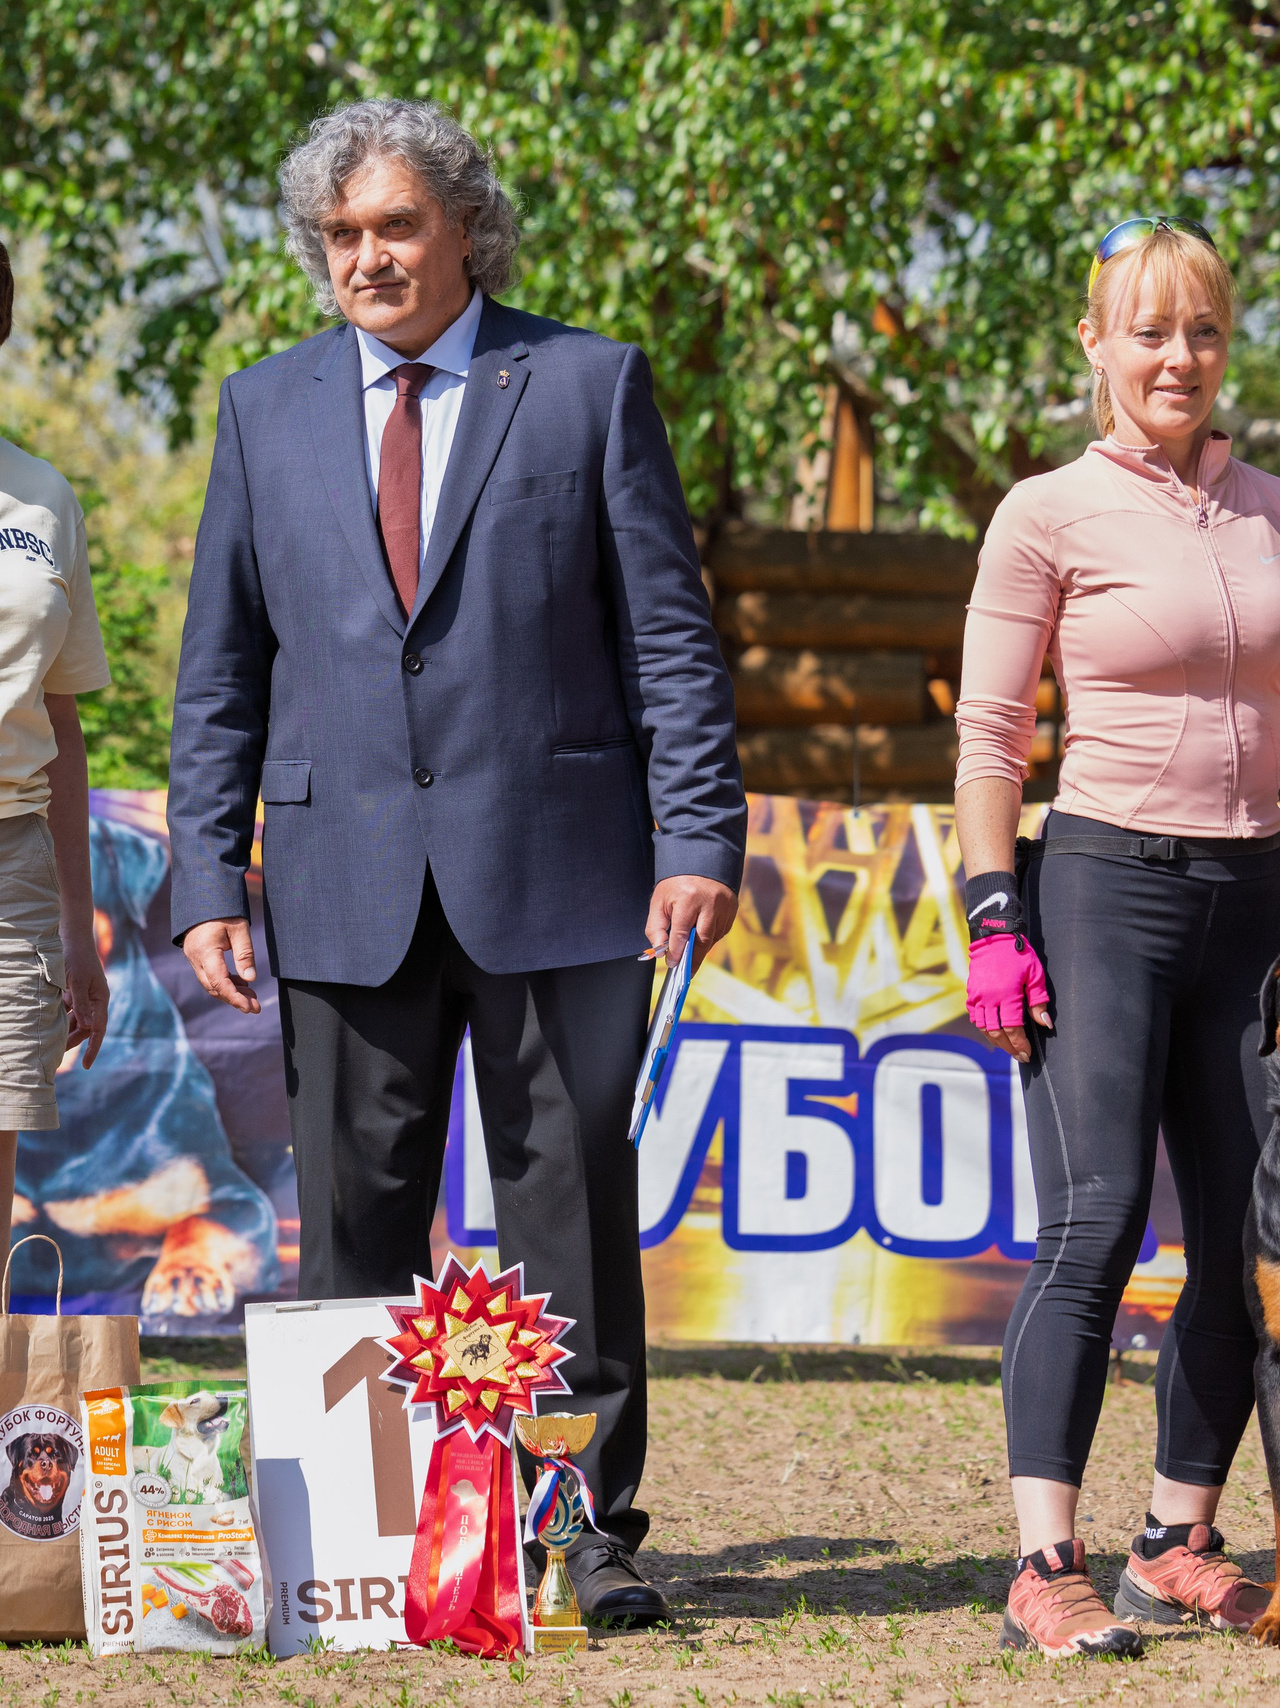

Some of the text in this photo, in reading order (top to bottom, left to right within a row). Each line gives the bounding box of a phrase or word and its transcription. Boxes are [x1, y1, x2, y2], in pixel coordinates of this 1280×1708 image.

[322, 1336, 418, 1537] 1
[94, 1445, 120, 1458] ADULT
[140, 1485, 165, 1495] 44%
[146, 1509, 191, 1519] ЯГНЕНОК
[156, 1519, 193, 1527] РИСОМ
[93, 1488, 134, 1636] SIRIUS
[279, 1581, 291, 1626] PREMIUM
[102, 1640, 135, 1648] PREMIUM
